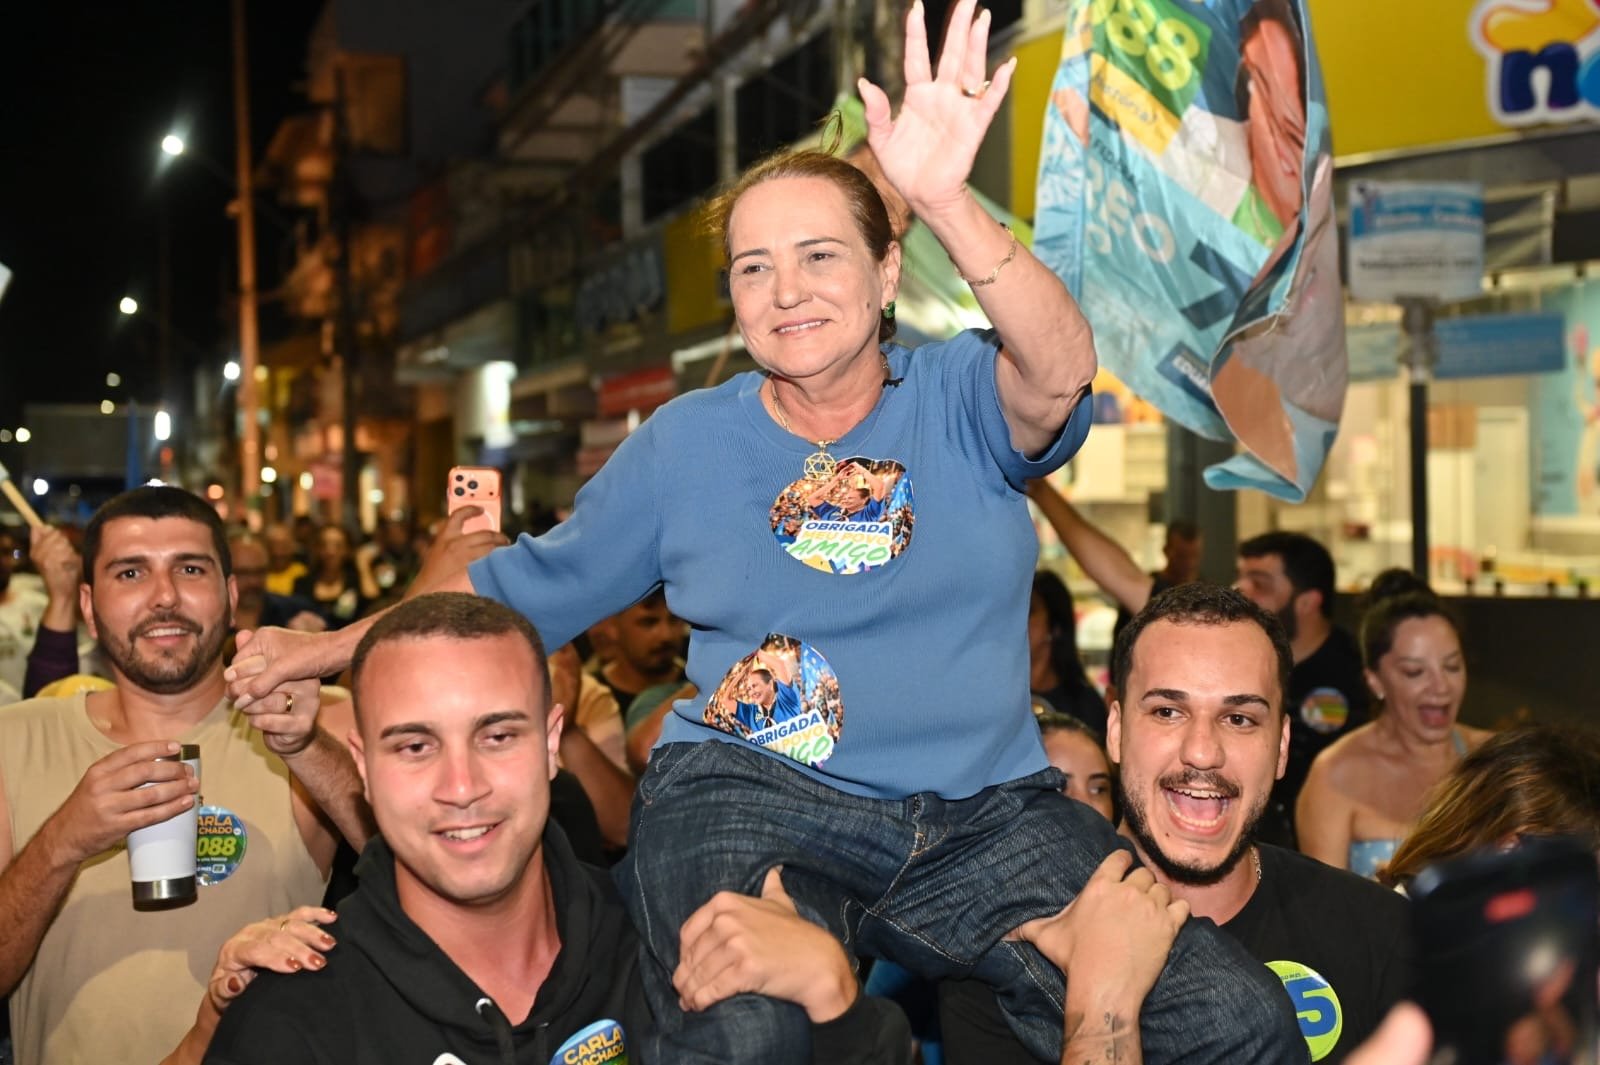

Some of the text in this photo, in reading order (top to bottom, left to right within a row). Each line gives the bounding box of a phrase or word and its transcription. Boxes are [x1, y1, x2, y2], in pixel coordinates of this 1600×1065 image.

[802, 531, 889, 545] MEU POVO
[805, 522, 890, 535] OBRIGADA
[789, 538, 888, 565] AMIGO
[782, 725, 824, 750] POVO
[789, 735, 830, 764] IGO
[197, 815, 233, 826] ARLA
[197, 836, 237, 857] 088
[563, 1025, 622, 1065] CARLA
[576, 1042, 624, 1065] ACHADO
